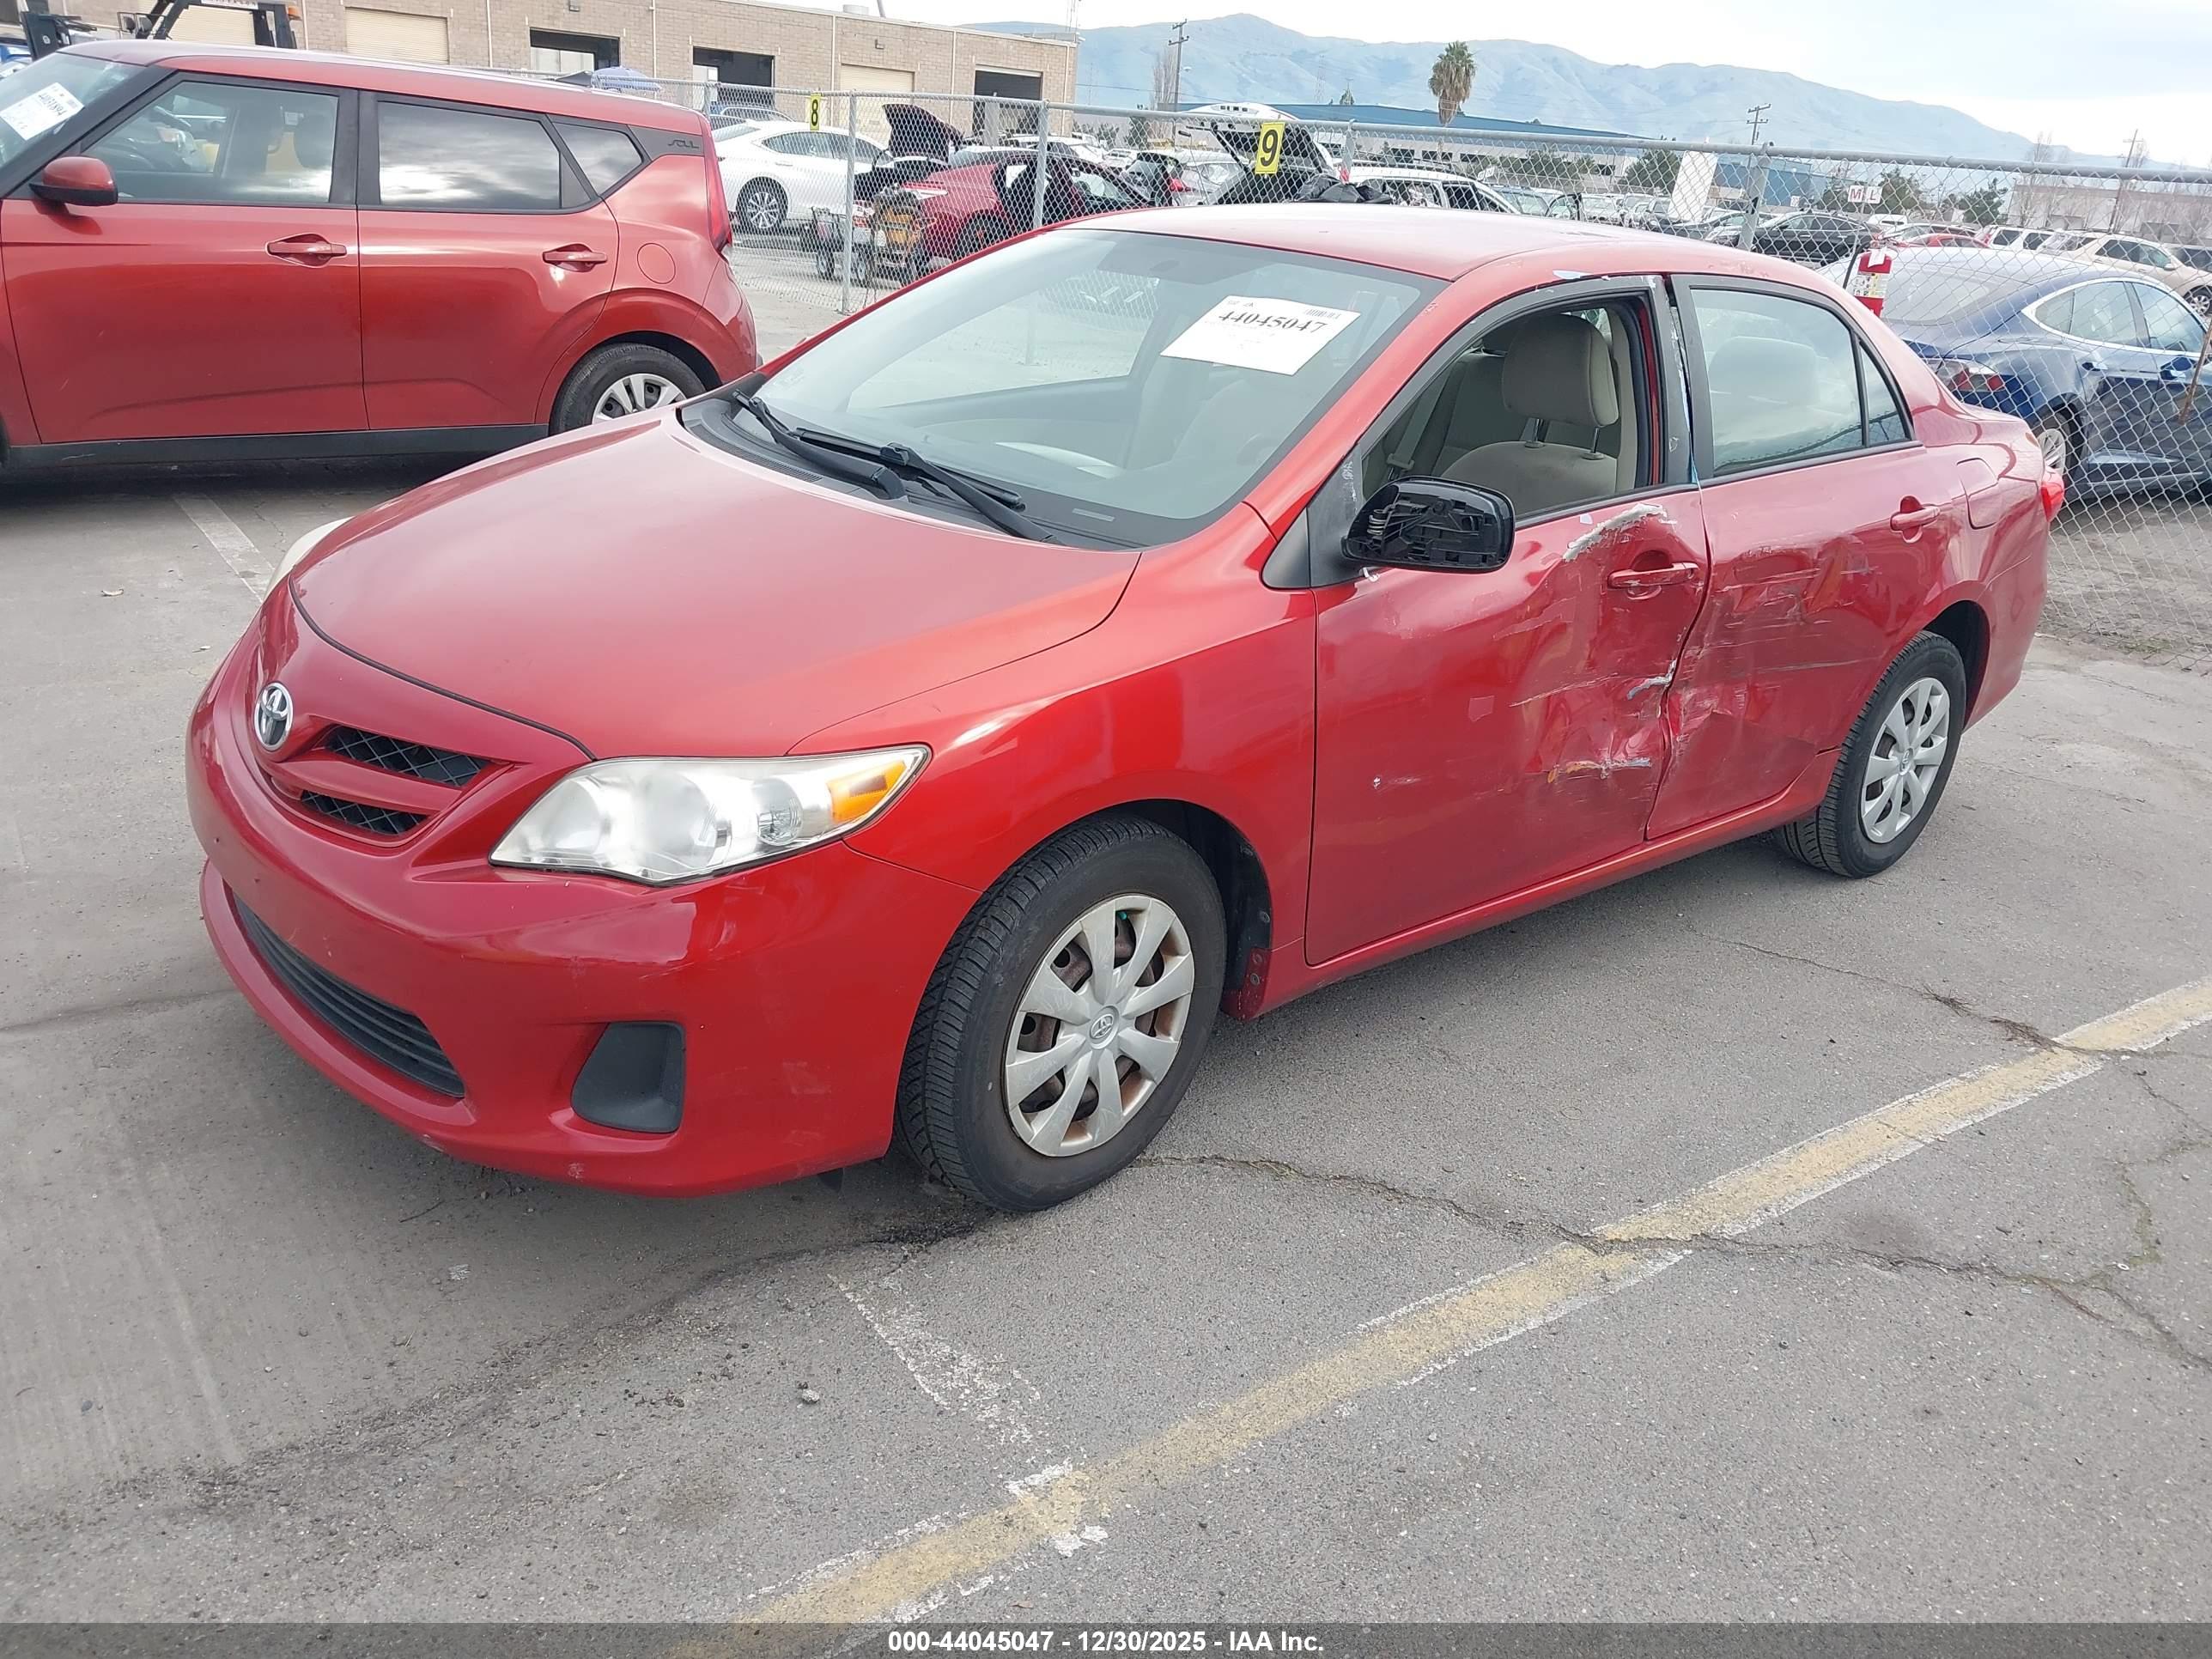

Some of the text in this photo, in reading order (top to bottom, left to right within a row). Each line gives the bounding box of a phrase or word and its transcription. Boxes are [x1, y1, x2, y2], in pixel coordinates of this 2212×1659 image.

[811, 99, 819, 127] 8
[1260, 129, 1279, 167] 9
[1869, 189, 1877, 201] L
[1218, 310, 1328, 333] 44045047
